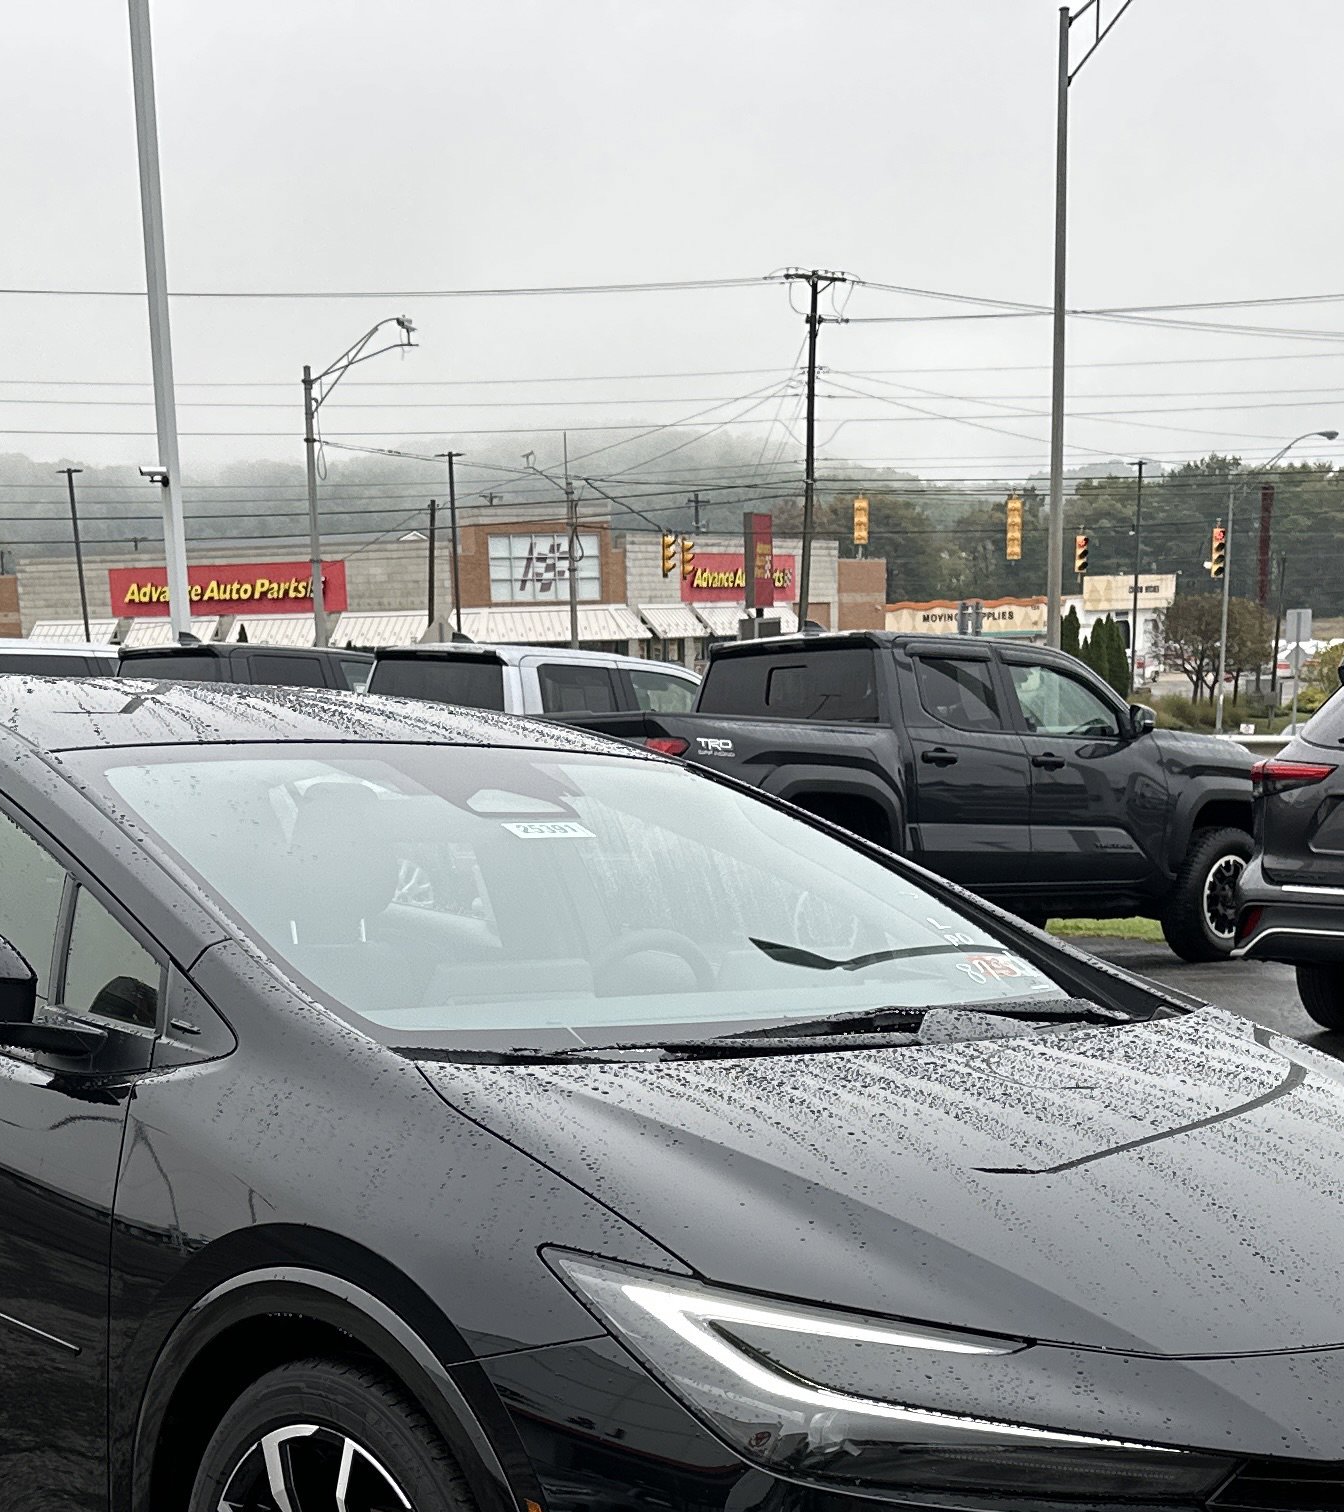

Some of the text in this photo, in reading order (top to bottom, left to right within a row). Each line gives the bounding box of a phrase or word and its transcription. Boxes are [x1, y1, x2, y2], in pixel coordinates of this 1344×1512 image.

[693, 568, 735, 588] Advance
[124, 578, 308, 604] Advae Auto Parts
[697, 738, 732, 750] TRD
[515, 824, 579, 834] 25391
